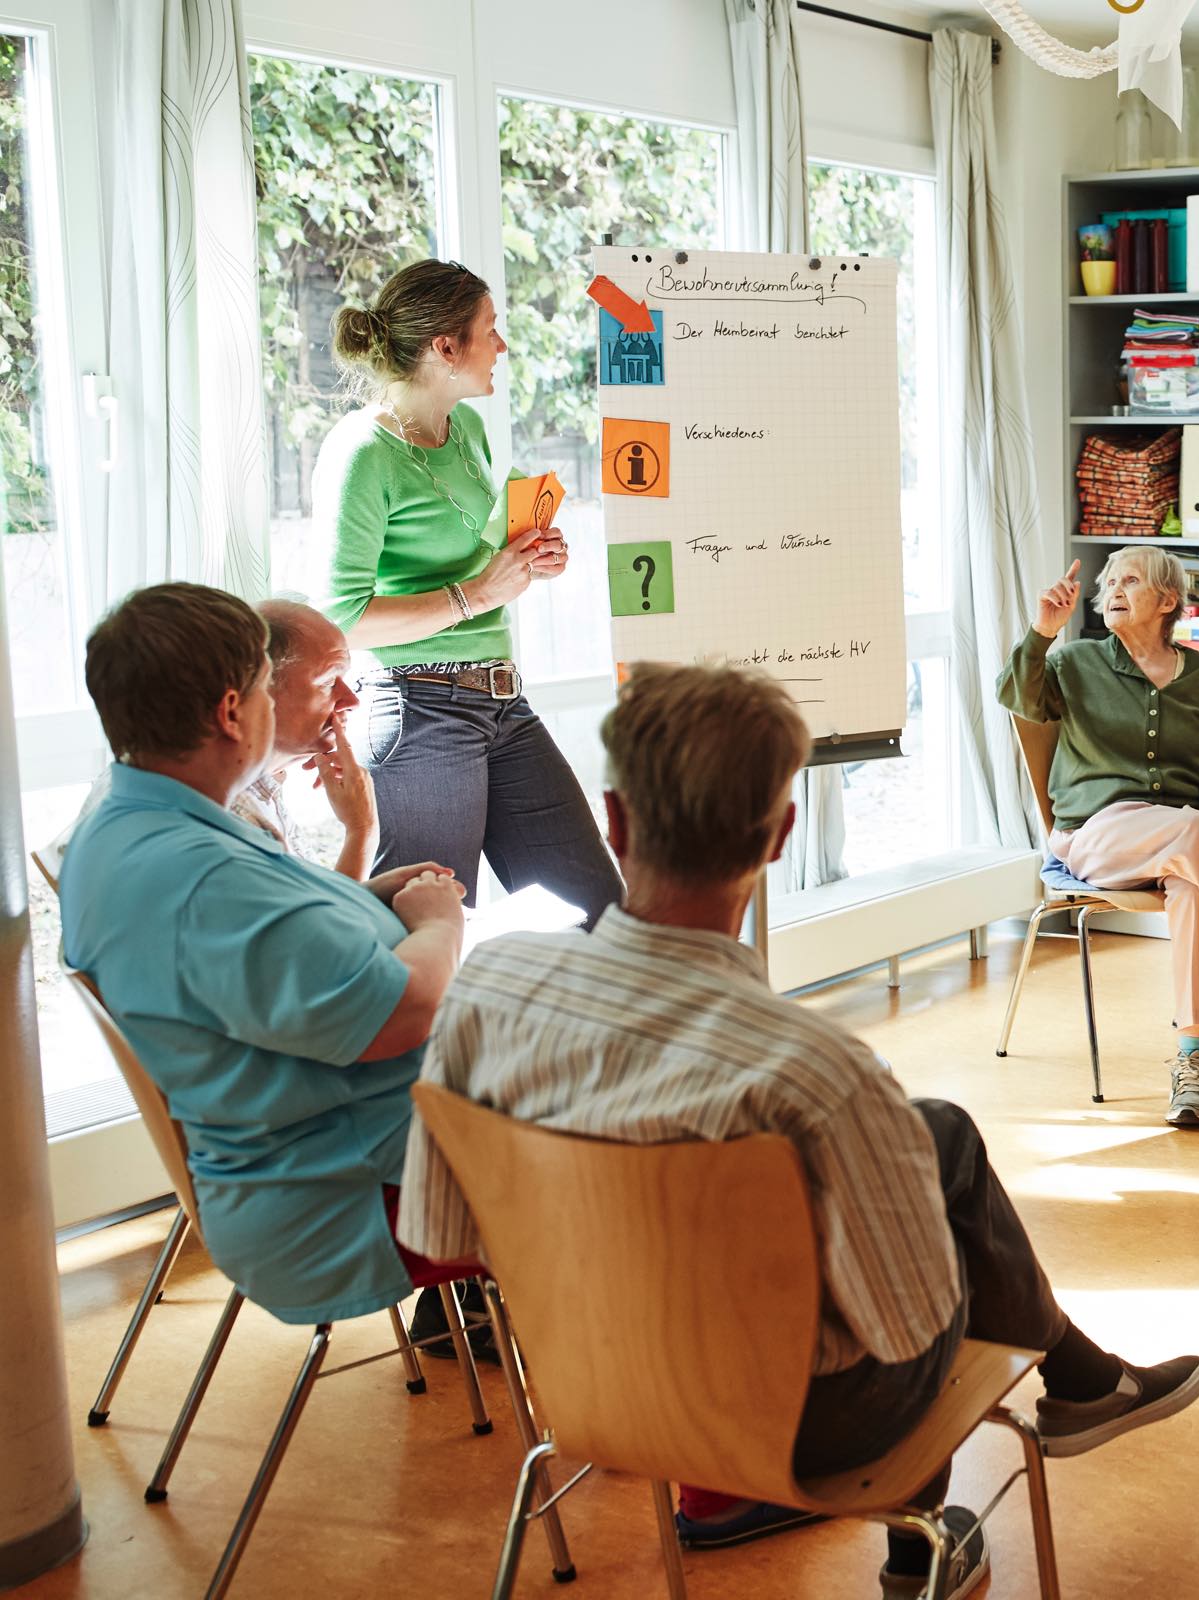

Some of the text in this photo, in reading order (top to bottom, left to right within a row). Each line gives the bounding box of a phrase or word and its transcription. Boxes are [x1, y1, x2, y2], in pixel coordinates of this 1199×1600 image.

[673, 322, 704, 340] Der
[745, 539, 768, 551] und
[777, 648, 795, 663] die
[849, 639, 871, 658] HV
